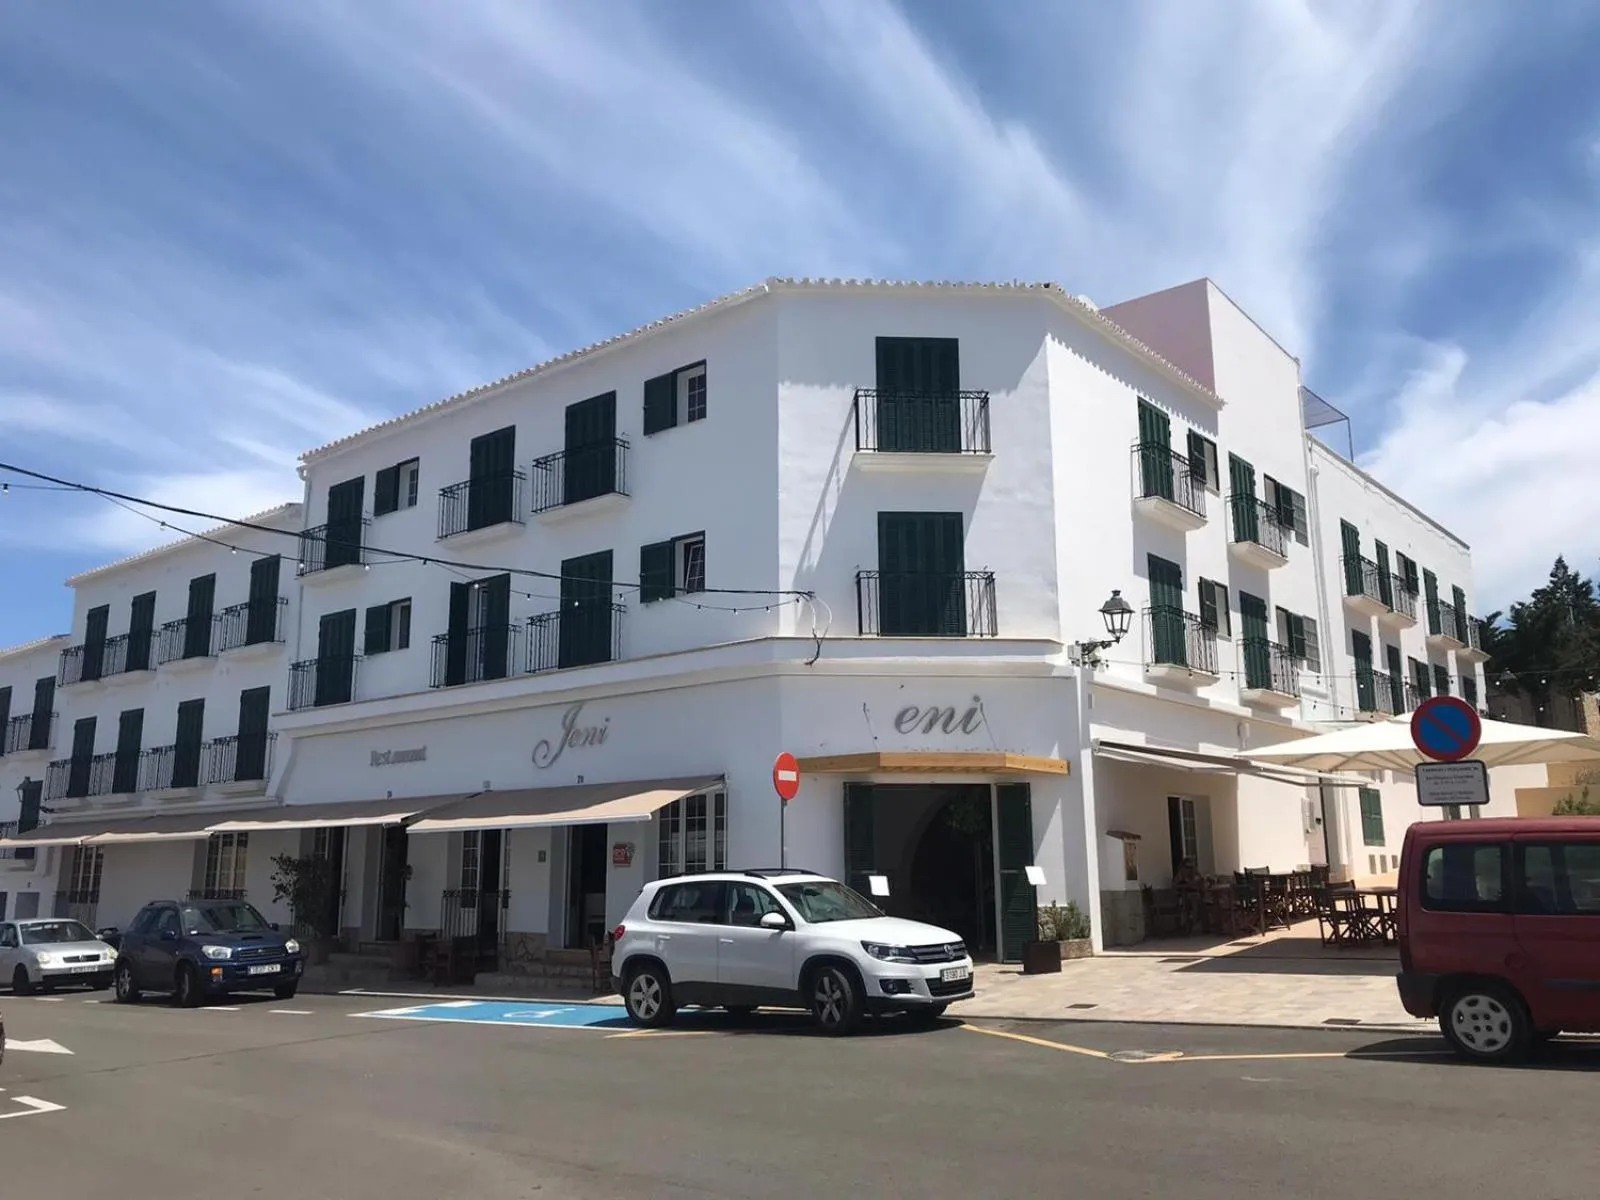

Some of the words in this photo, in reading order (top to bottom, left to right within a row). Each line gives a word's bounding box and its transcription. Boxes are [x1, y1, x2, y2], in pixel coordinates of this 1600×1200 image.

[532, 701, 611, 769] Jeni
[894, 694, 982, 735] eni
[370, 745, 427, 767] Restt
